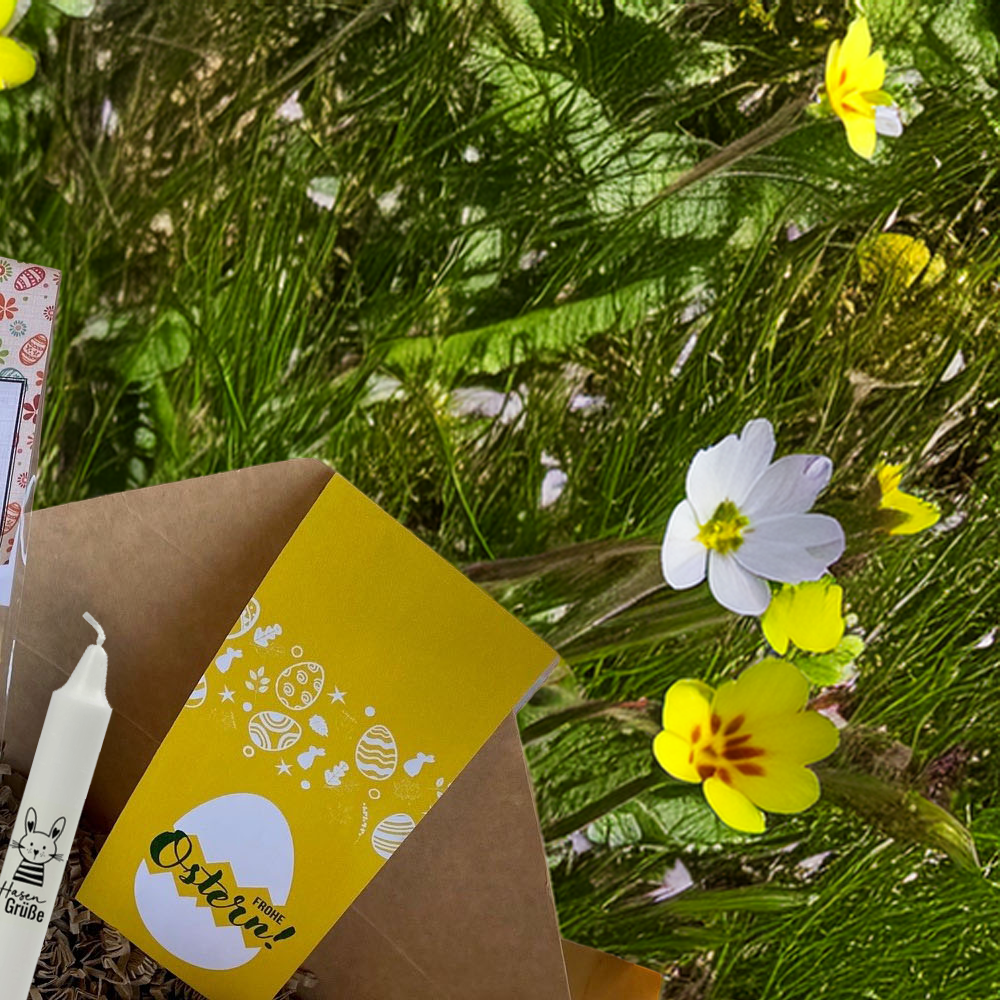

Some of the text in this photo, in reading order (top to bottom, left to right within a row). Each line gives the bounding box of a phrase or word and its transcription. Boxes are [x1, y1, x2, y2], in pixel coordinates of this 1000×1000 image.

[150, 829, 296, 950] Ostern!
[4, 897, 45, 923] Grüße
[252, 896, 286, 925] FROHE
